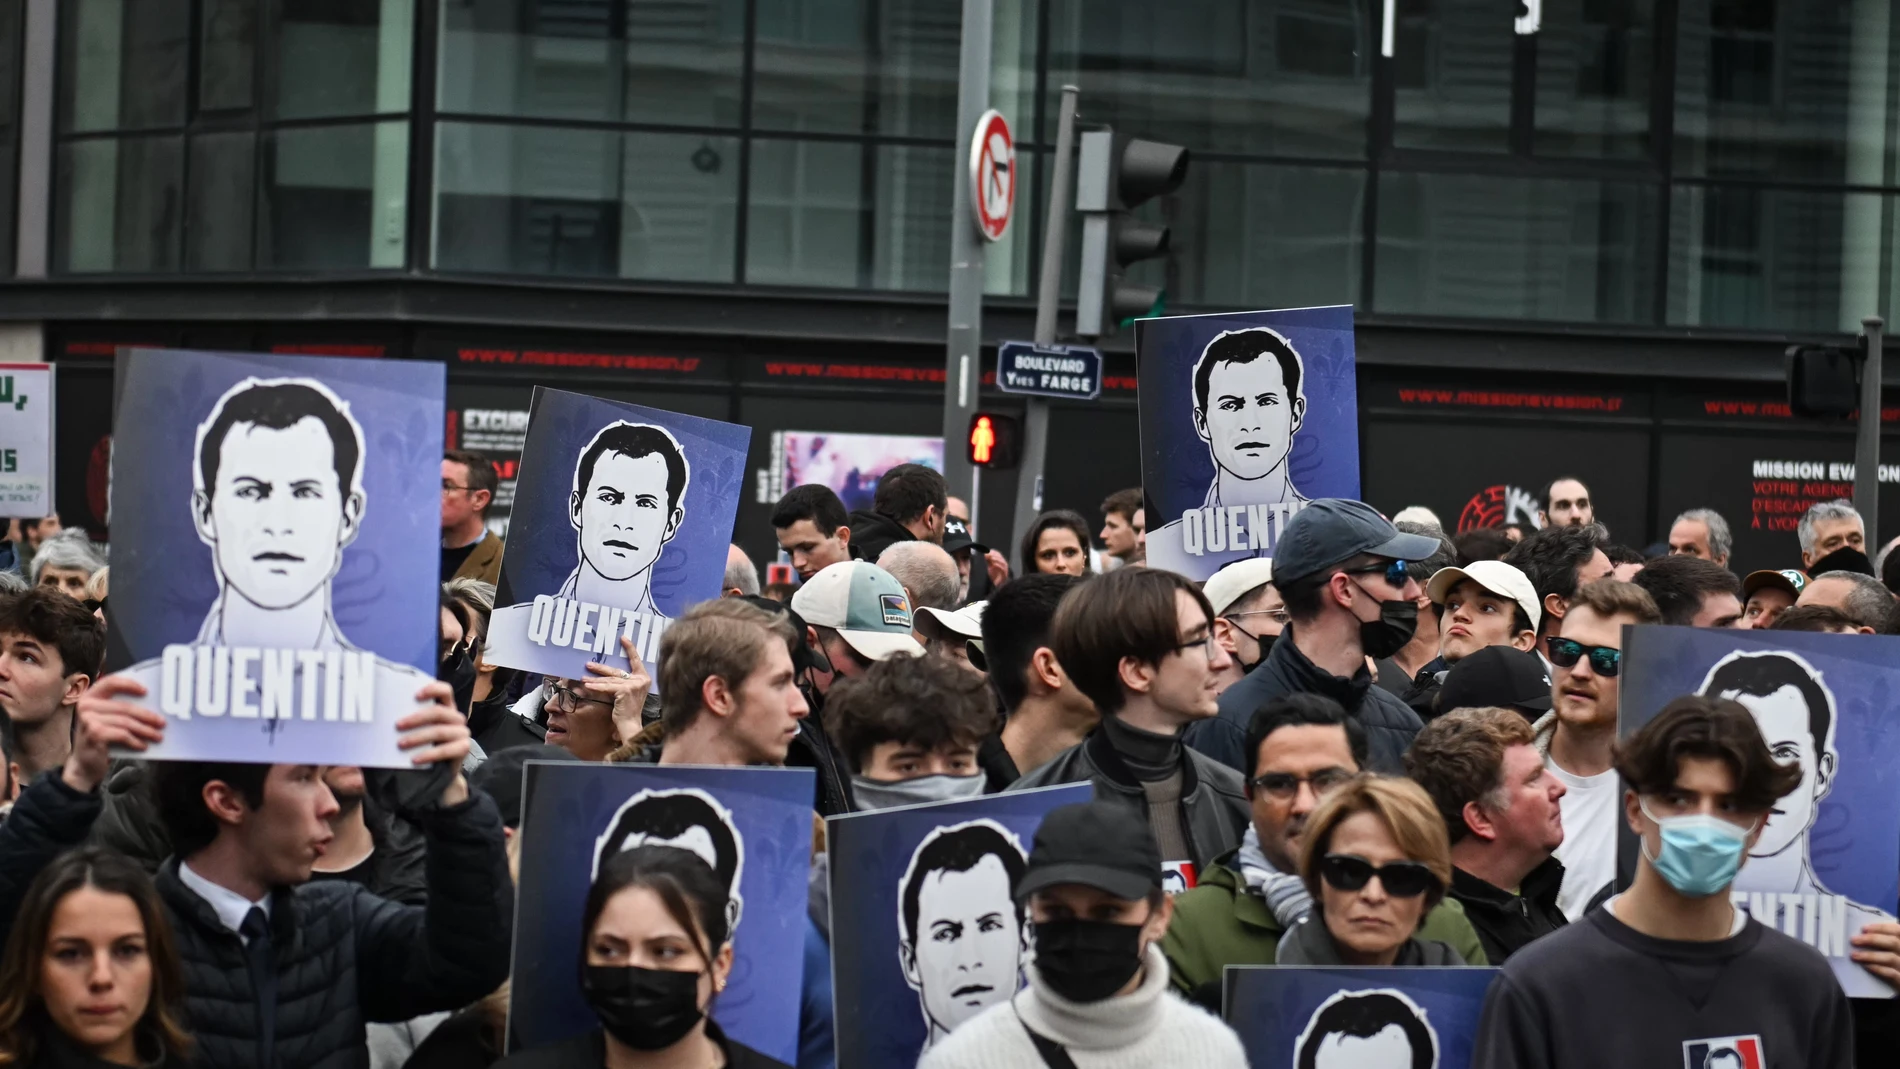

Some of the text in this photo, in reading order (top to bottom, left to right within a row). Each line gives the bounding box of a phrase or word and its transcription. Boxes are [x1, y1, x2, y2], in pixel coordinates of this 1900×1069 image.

[1015, 355, 1085, 374] BOULEVARD
[1040, 374, 1091, 392] FARGE
[1752, 460, 1900, 483] MISSION EVAON
[1752, 481, 1799, 495] VOTRE
[1752, 499, 1816, 513] D'ESCAP
[1182, 501, 1307, 556] QUENT
[161, 643, 375, 722] QUENTIN
